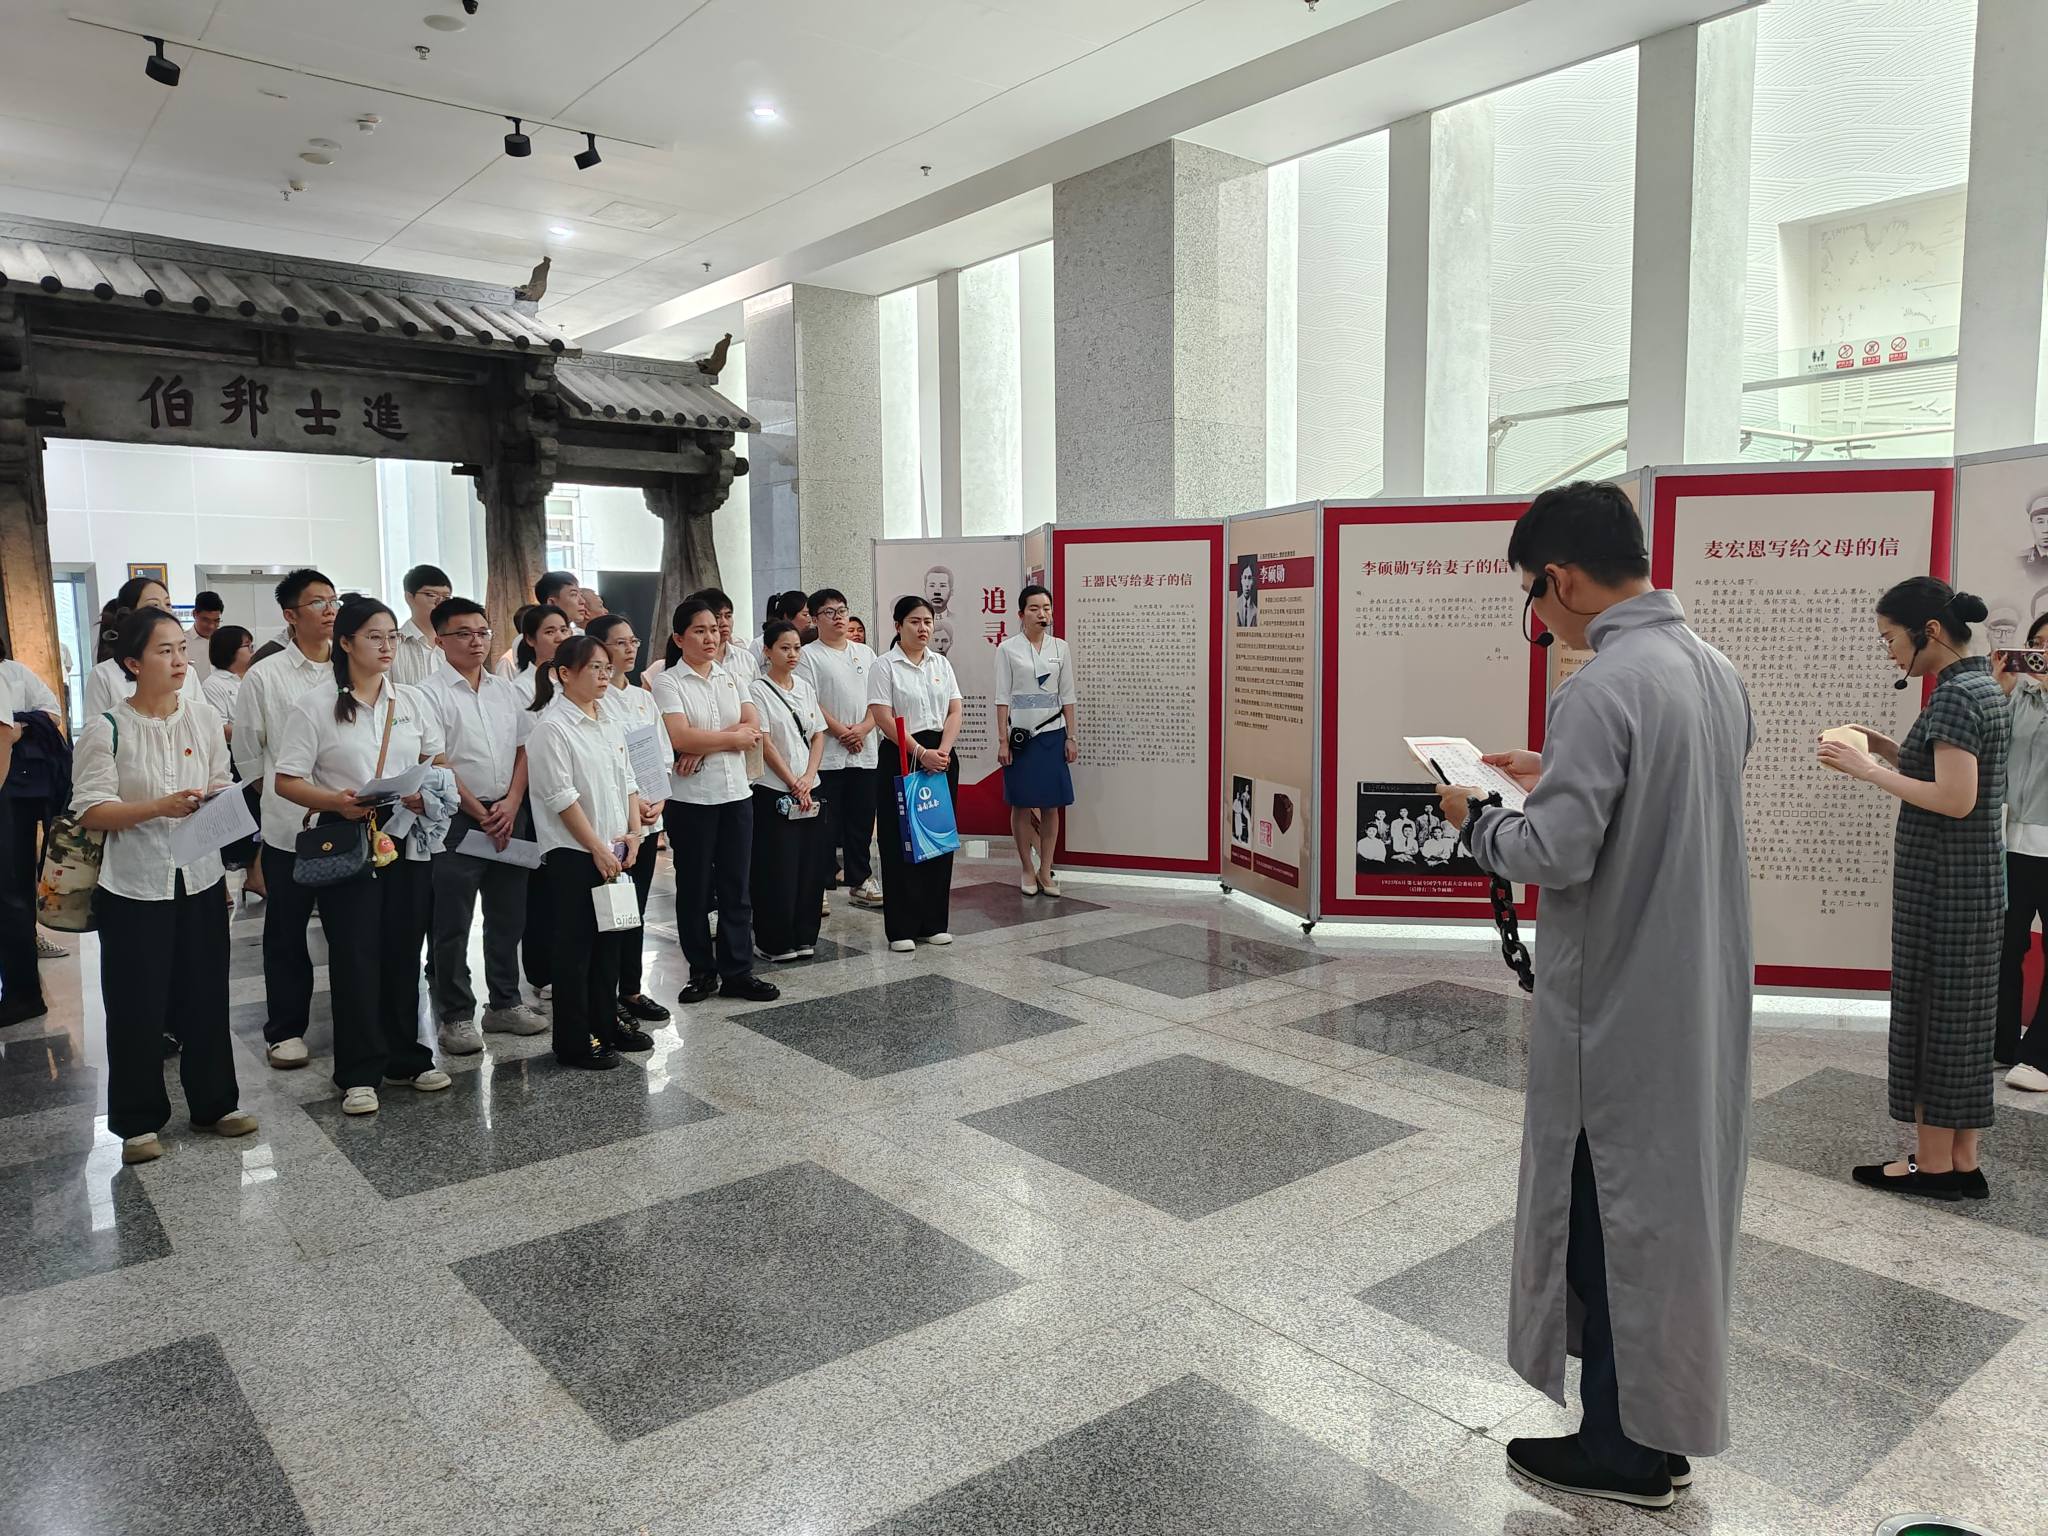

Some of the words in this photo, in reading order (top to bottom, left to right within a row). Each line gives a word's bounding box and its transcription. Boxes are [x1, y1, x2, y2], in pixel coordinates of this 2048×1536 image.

[1704, 537, 1900, 559] 麦宏恩写给父母的信
[1260, 564, 1285, 584] 李硕勋
[1361, 559, 1509, 576] 李硕勋写给妻子的信
[1080, 573, 1193, 587] 王器民写给妻子的信
